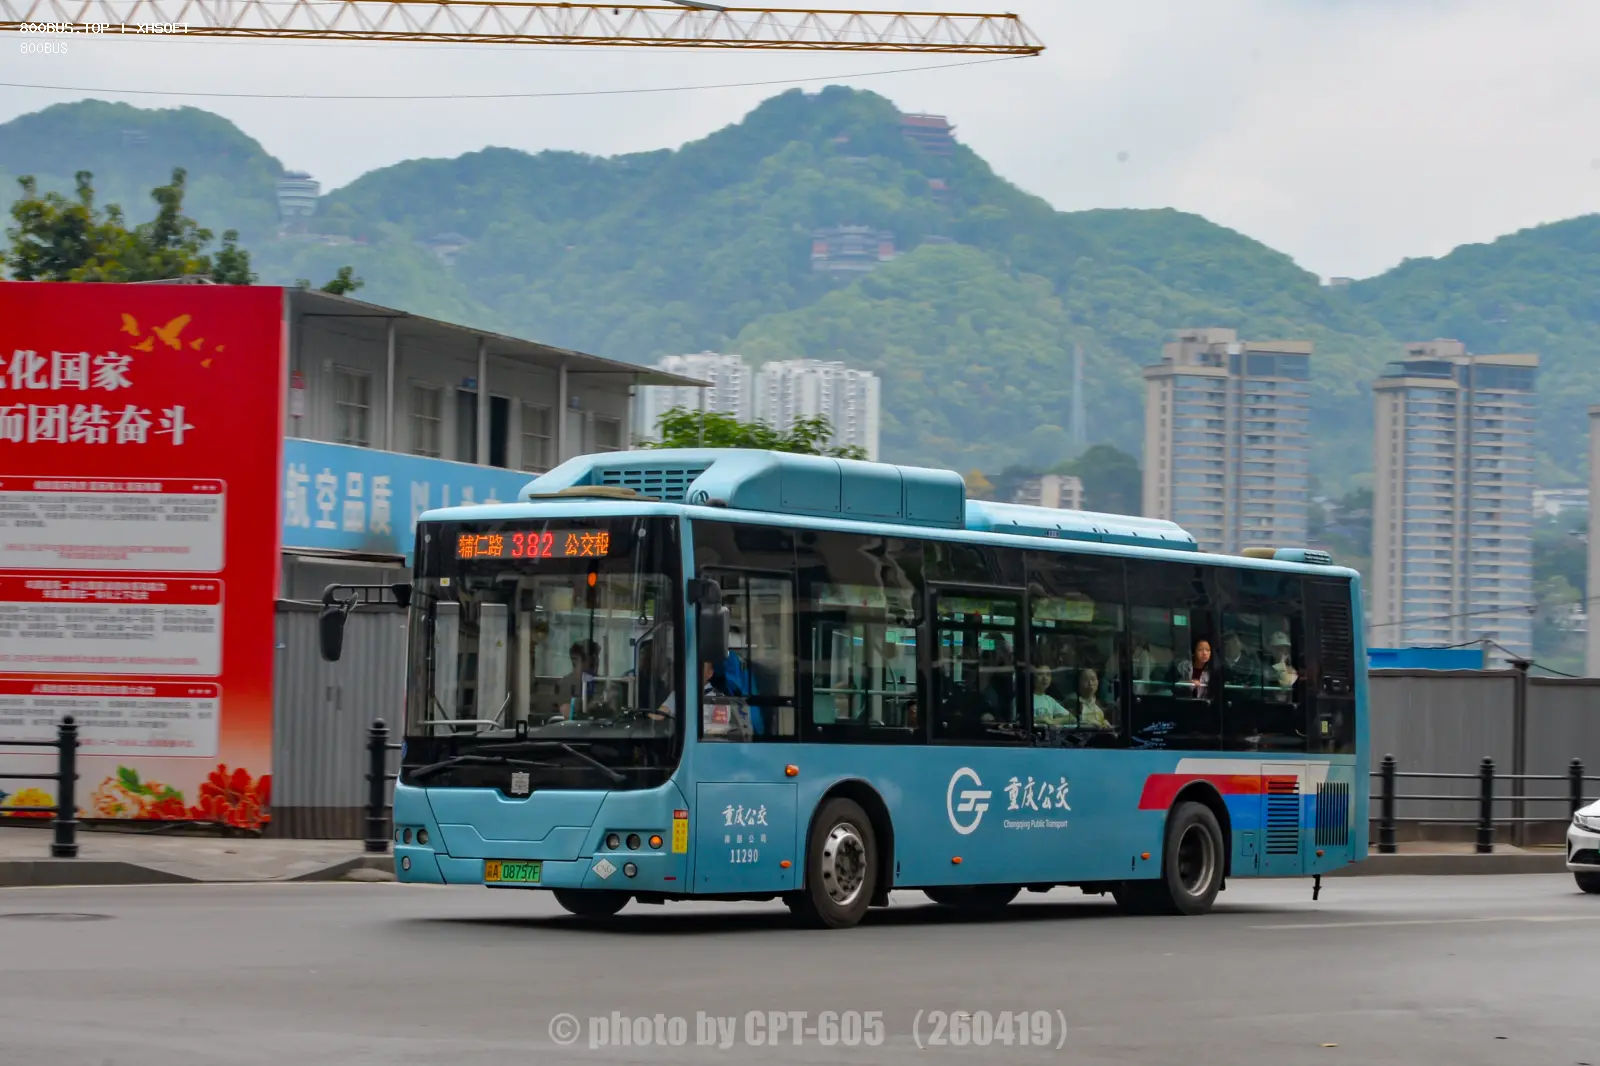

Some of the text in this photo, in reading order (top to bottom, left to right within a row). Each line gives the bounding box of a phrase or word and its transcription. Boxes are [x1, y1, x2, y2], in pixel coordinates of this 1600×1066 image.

[0, 349, 134, 391] 化国家
[511, 532, 554, 557] 382
[1003, 776, 1072, 812] 重庆公交
[722, 804, 769, 827] 重庆公交
[730, 848, 759, 864] 11290
